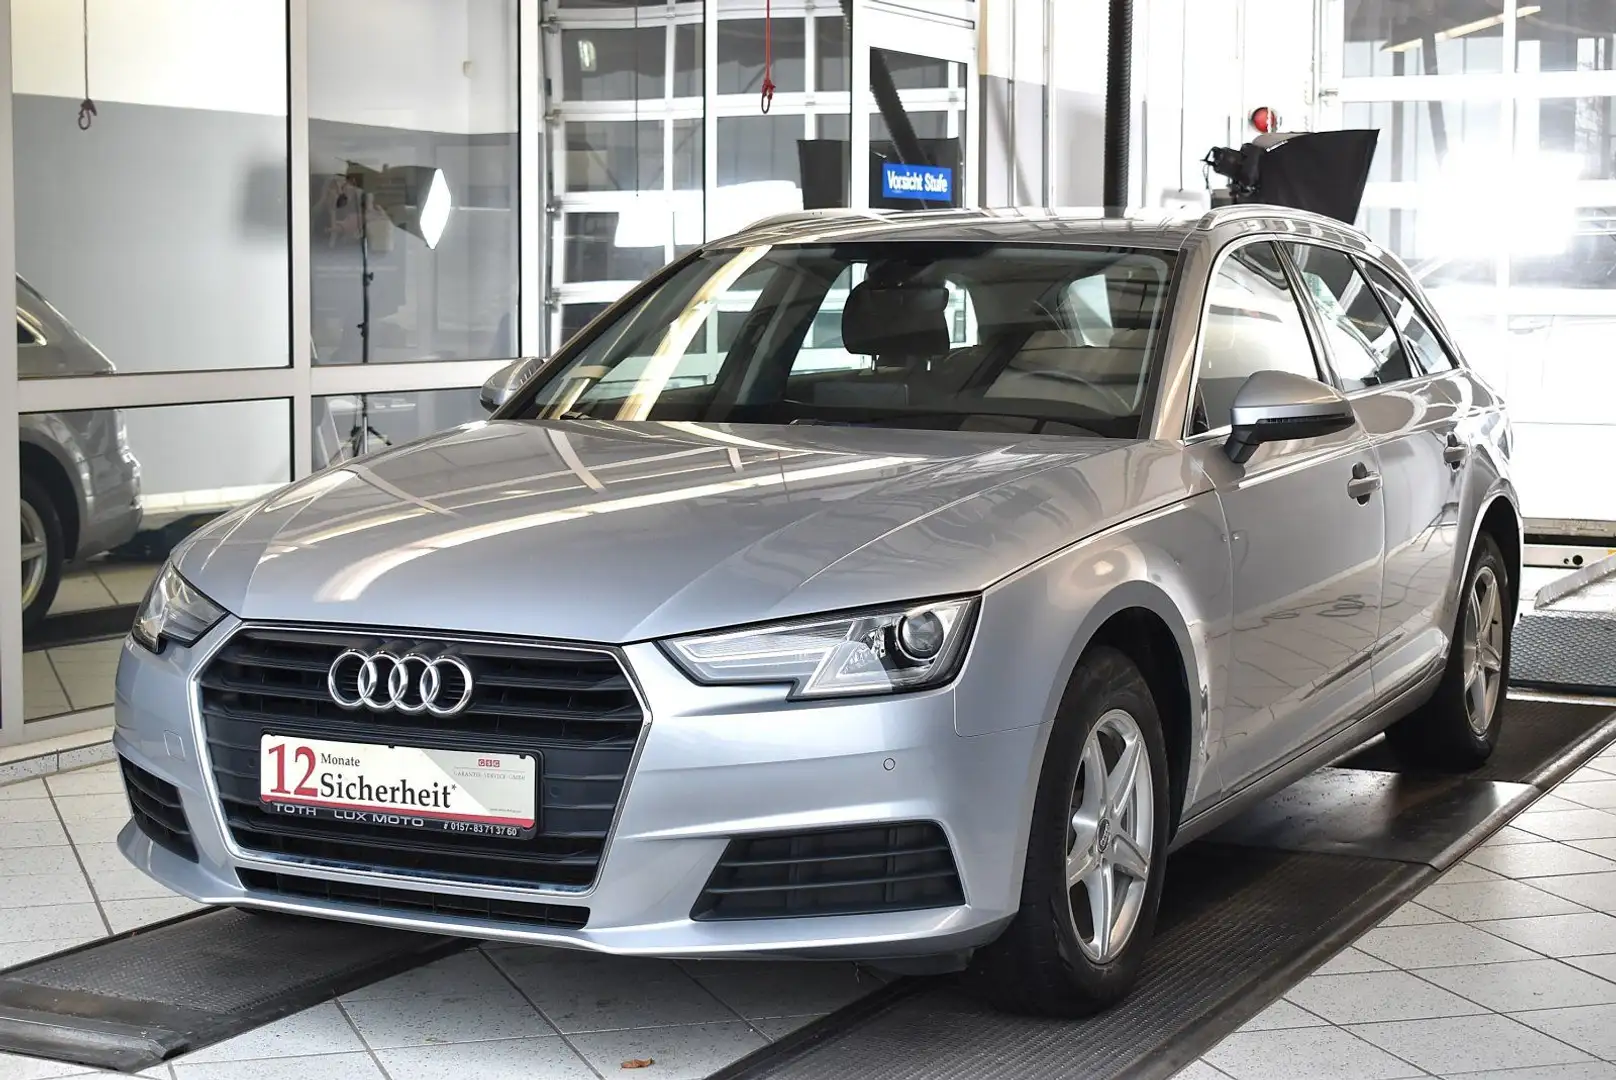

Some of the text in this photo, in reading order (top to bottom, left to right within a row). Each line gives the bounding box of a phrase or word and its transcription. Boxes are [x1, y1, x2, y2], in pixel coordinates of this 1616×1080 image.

[887, 169, 948, 193] Vorsicht Stufe
[268, 743, 318, 797] 12
[320, 752, 361, 767] Monate
[272, 802, 424, 827] TOTH LUX MOTO
[485, 825, 494, 834] 71
[495, 826, 506, 835] 37
[506, 827, 518, 836] 60
